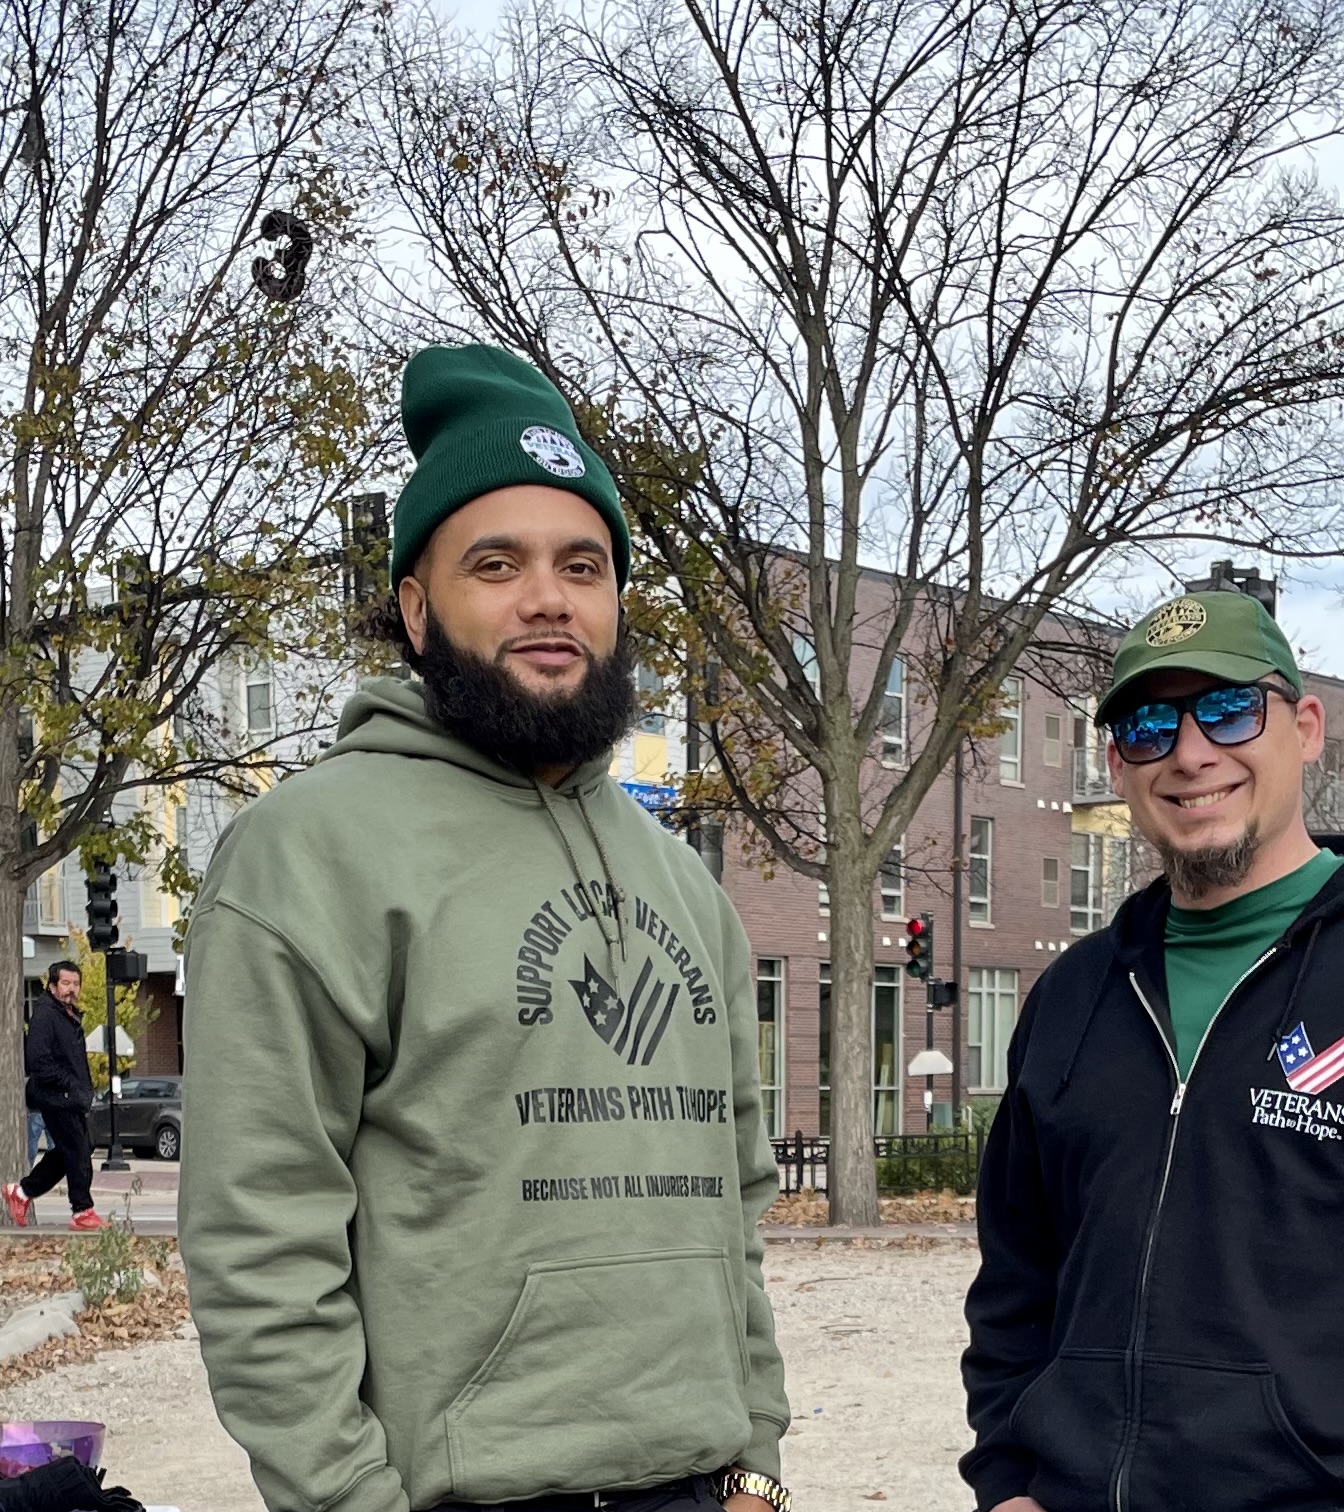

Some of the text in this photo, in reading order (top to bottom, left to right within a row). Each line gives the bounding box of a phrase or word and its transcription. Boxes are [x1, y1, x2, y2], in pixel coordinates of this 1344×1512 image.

[517, 880, 716, 1027] SUPPORT LOCA VETERANS
[515, 1086, 625, 1127] VETERANS
[627, 1085, 675, 1121] PATH
[1252, 1106, 1286, 1129] Path
[522, 1177, 588, 1201] BECAUSE
[590, 1176, 620, 1199] NOT
[624, 1176, 644, 1198] ALL
[645, 1175, 689, 1198] INJURIES
